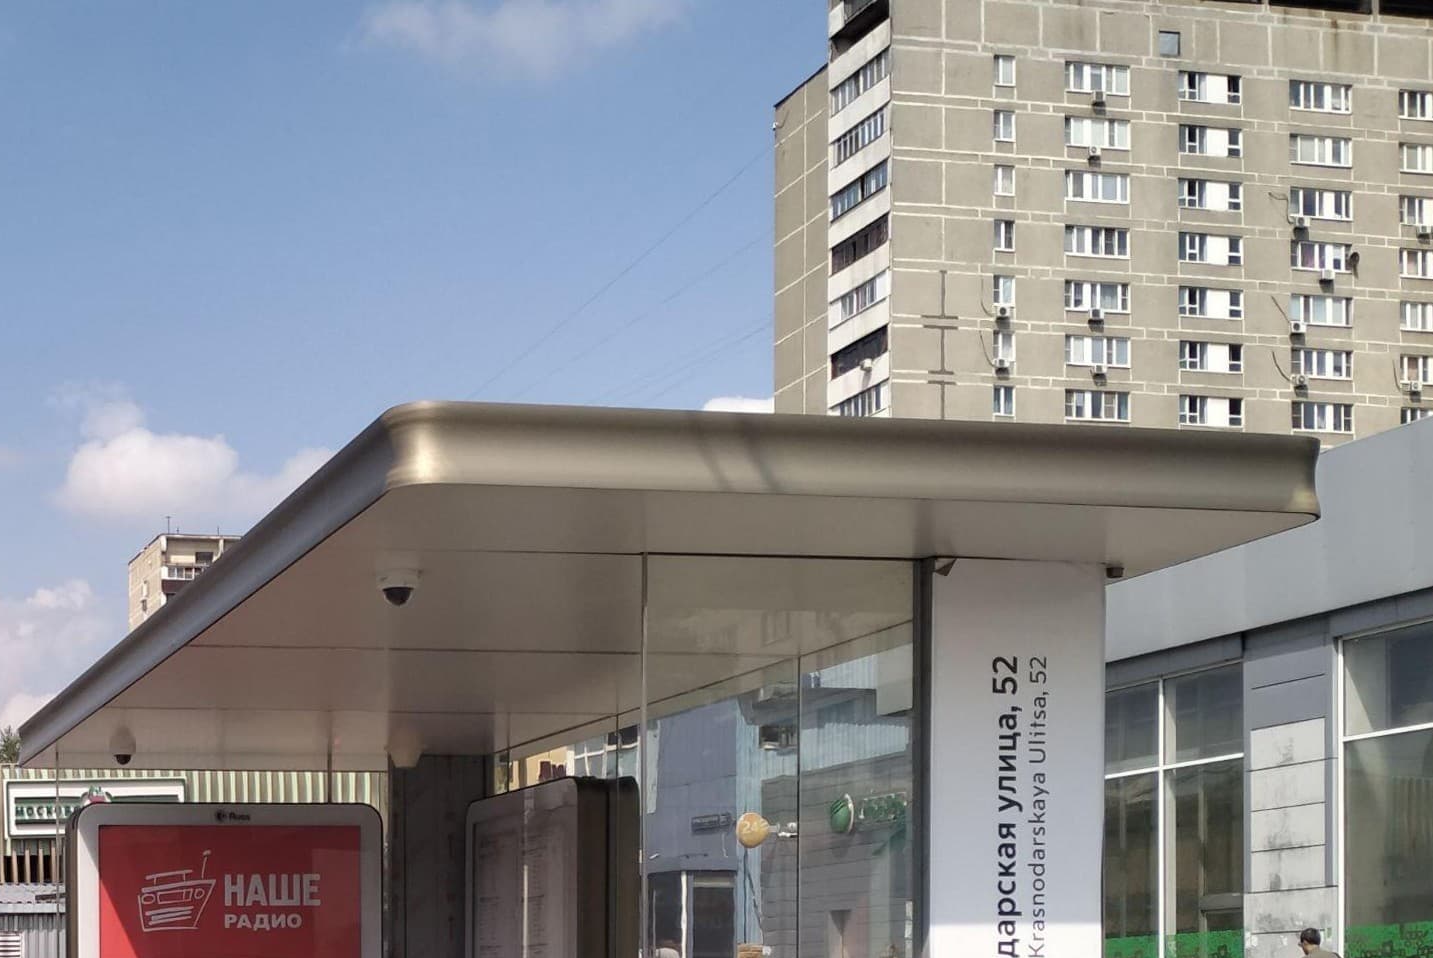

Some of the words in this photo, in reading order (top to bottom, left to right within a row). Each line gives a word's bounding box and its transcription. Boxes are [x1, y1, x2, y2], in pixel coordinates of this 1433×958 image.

[992, 656, 1019, 694] 52
[1029, 656, 1047, 681] 52
[1029, 688, 1050, 764] Ulitsa,
[997, 705, 1023, 813] улица,
[1028, 772, 1050, 958] Krasnodarskaya
[223, 873, 321, 906] НАШЕ
[224, 914, 302, 932] РАДИО
